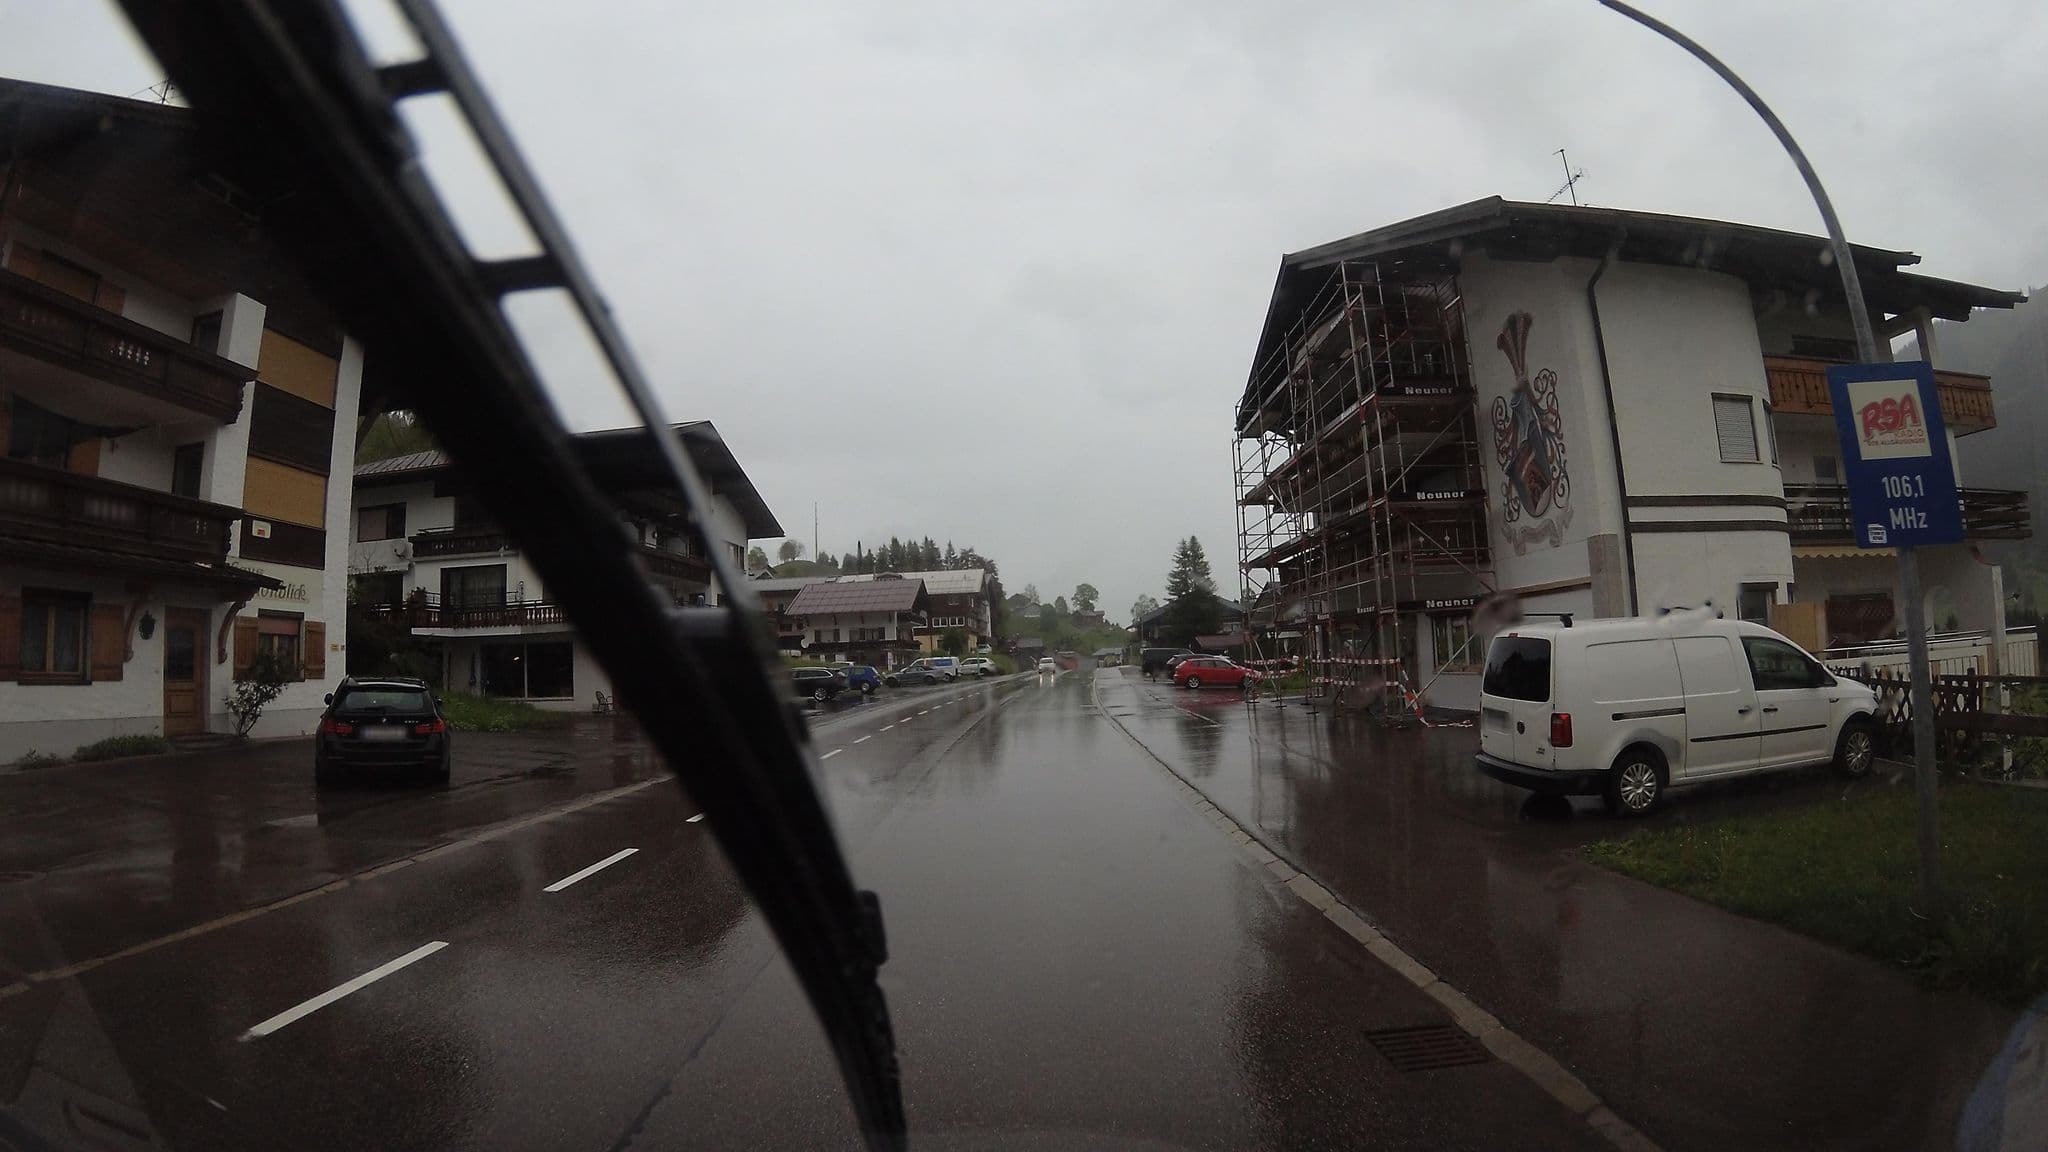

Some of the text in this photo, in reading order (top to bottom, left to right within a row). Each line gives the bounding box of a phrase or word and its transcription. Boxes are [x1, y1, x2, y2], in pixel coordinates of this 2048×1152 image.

[1405, 386, 1453, 395] Neuner
[1857, 394, 1921, 440] RSA
[1416, 490, 1465, 500] Neuner
[1889, 507, 1929, 530] MHz
[1426, 598, 1475, 608] Neuner
